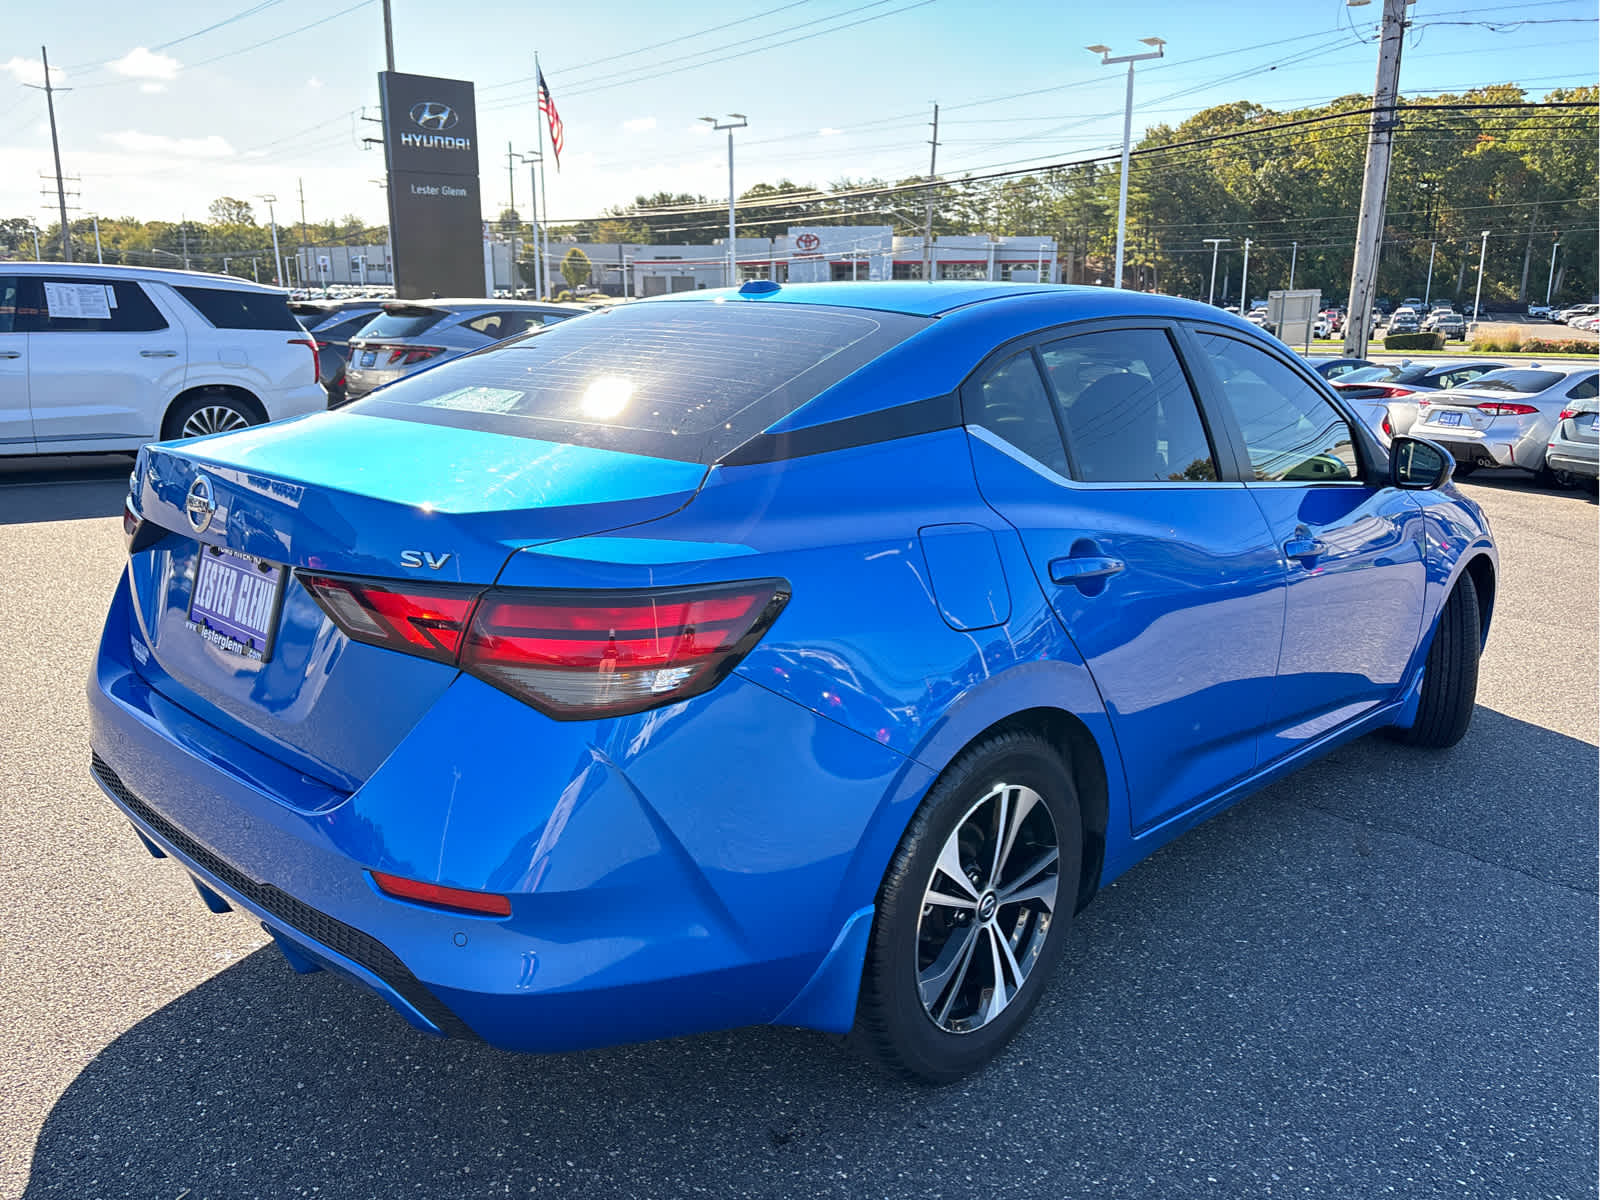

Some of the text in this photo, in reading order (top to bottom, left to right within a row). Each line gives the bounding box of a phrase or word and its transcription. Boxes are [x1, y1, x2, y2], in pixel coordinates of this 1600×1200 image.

[401, 132, 471, 151] HYUNDAI
[411, 184, 467, 197] Lester Glenn
[400, 550, 451, 570] SV
[194, 559, 277, 634] LESTER GLENN
[185, 621, 262, 661] wwwlesterglenn.com
